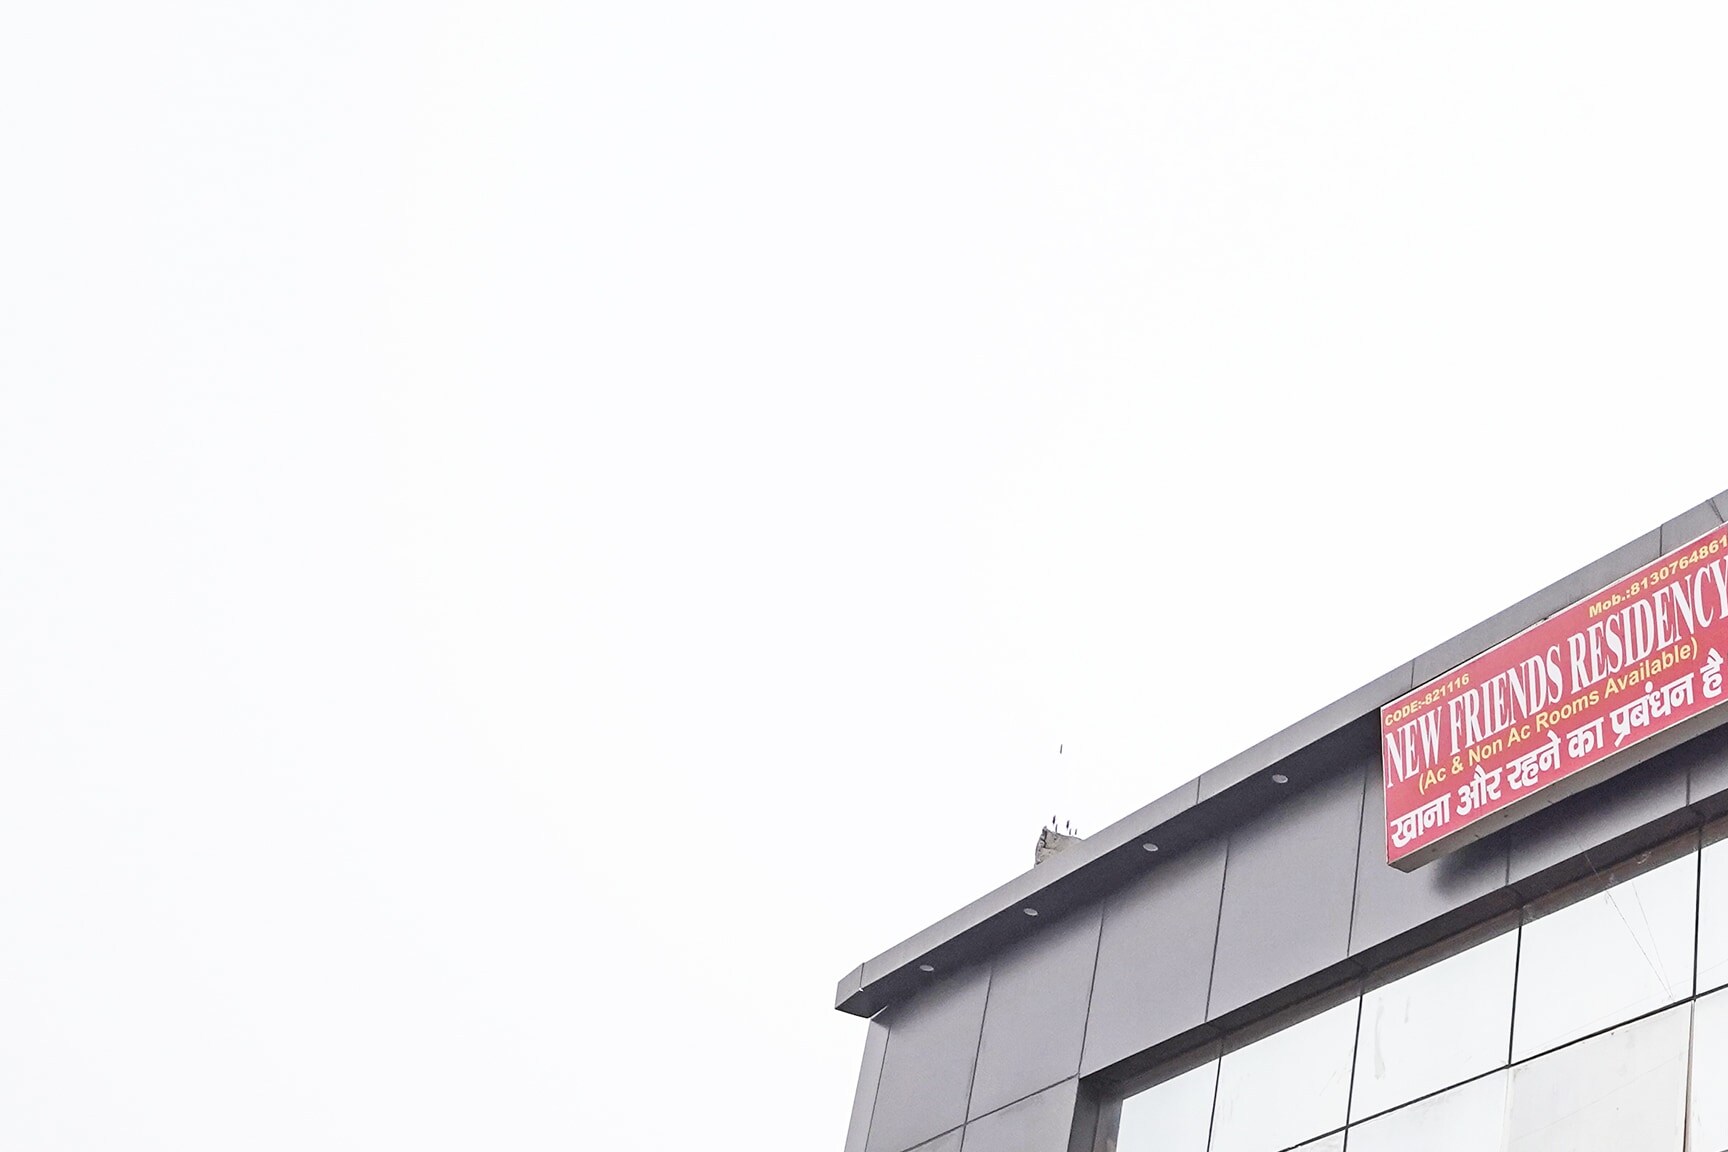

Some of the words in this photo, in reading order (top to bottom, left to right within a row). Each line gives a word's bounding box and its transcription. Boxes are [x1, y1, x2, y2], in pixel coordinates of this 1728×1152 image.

[1588, 535, 1728, 618] Mob.:8130764861
[1385, 673, 1469, 727] CODE:-821116
[1386, 709, 1442, 789] NEW
[1449, 644, 1561, 756] FRIENDS
[1390, 792, 1451, 848] खाना
[1456, 760, 1503, 816] और
[1505, 730, 1561, 790] रहने
[1566, 717, 1605, 760] का
[1609, 672, 1695, 748] प्रबंधन
[1418, 766, 1446, 795] (Ac
[1451, 757, 1464, 776] &
[1468, 738, 1503, 768] Non
[1507, 723, 1531, 747] Ac
[1536, 692, 1600, 733] Rooms
[1604, 637, 1698, 699] Available)
